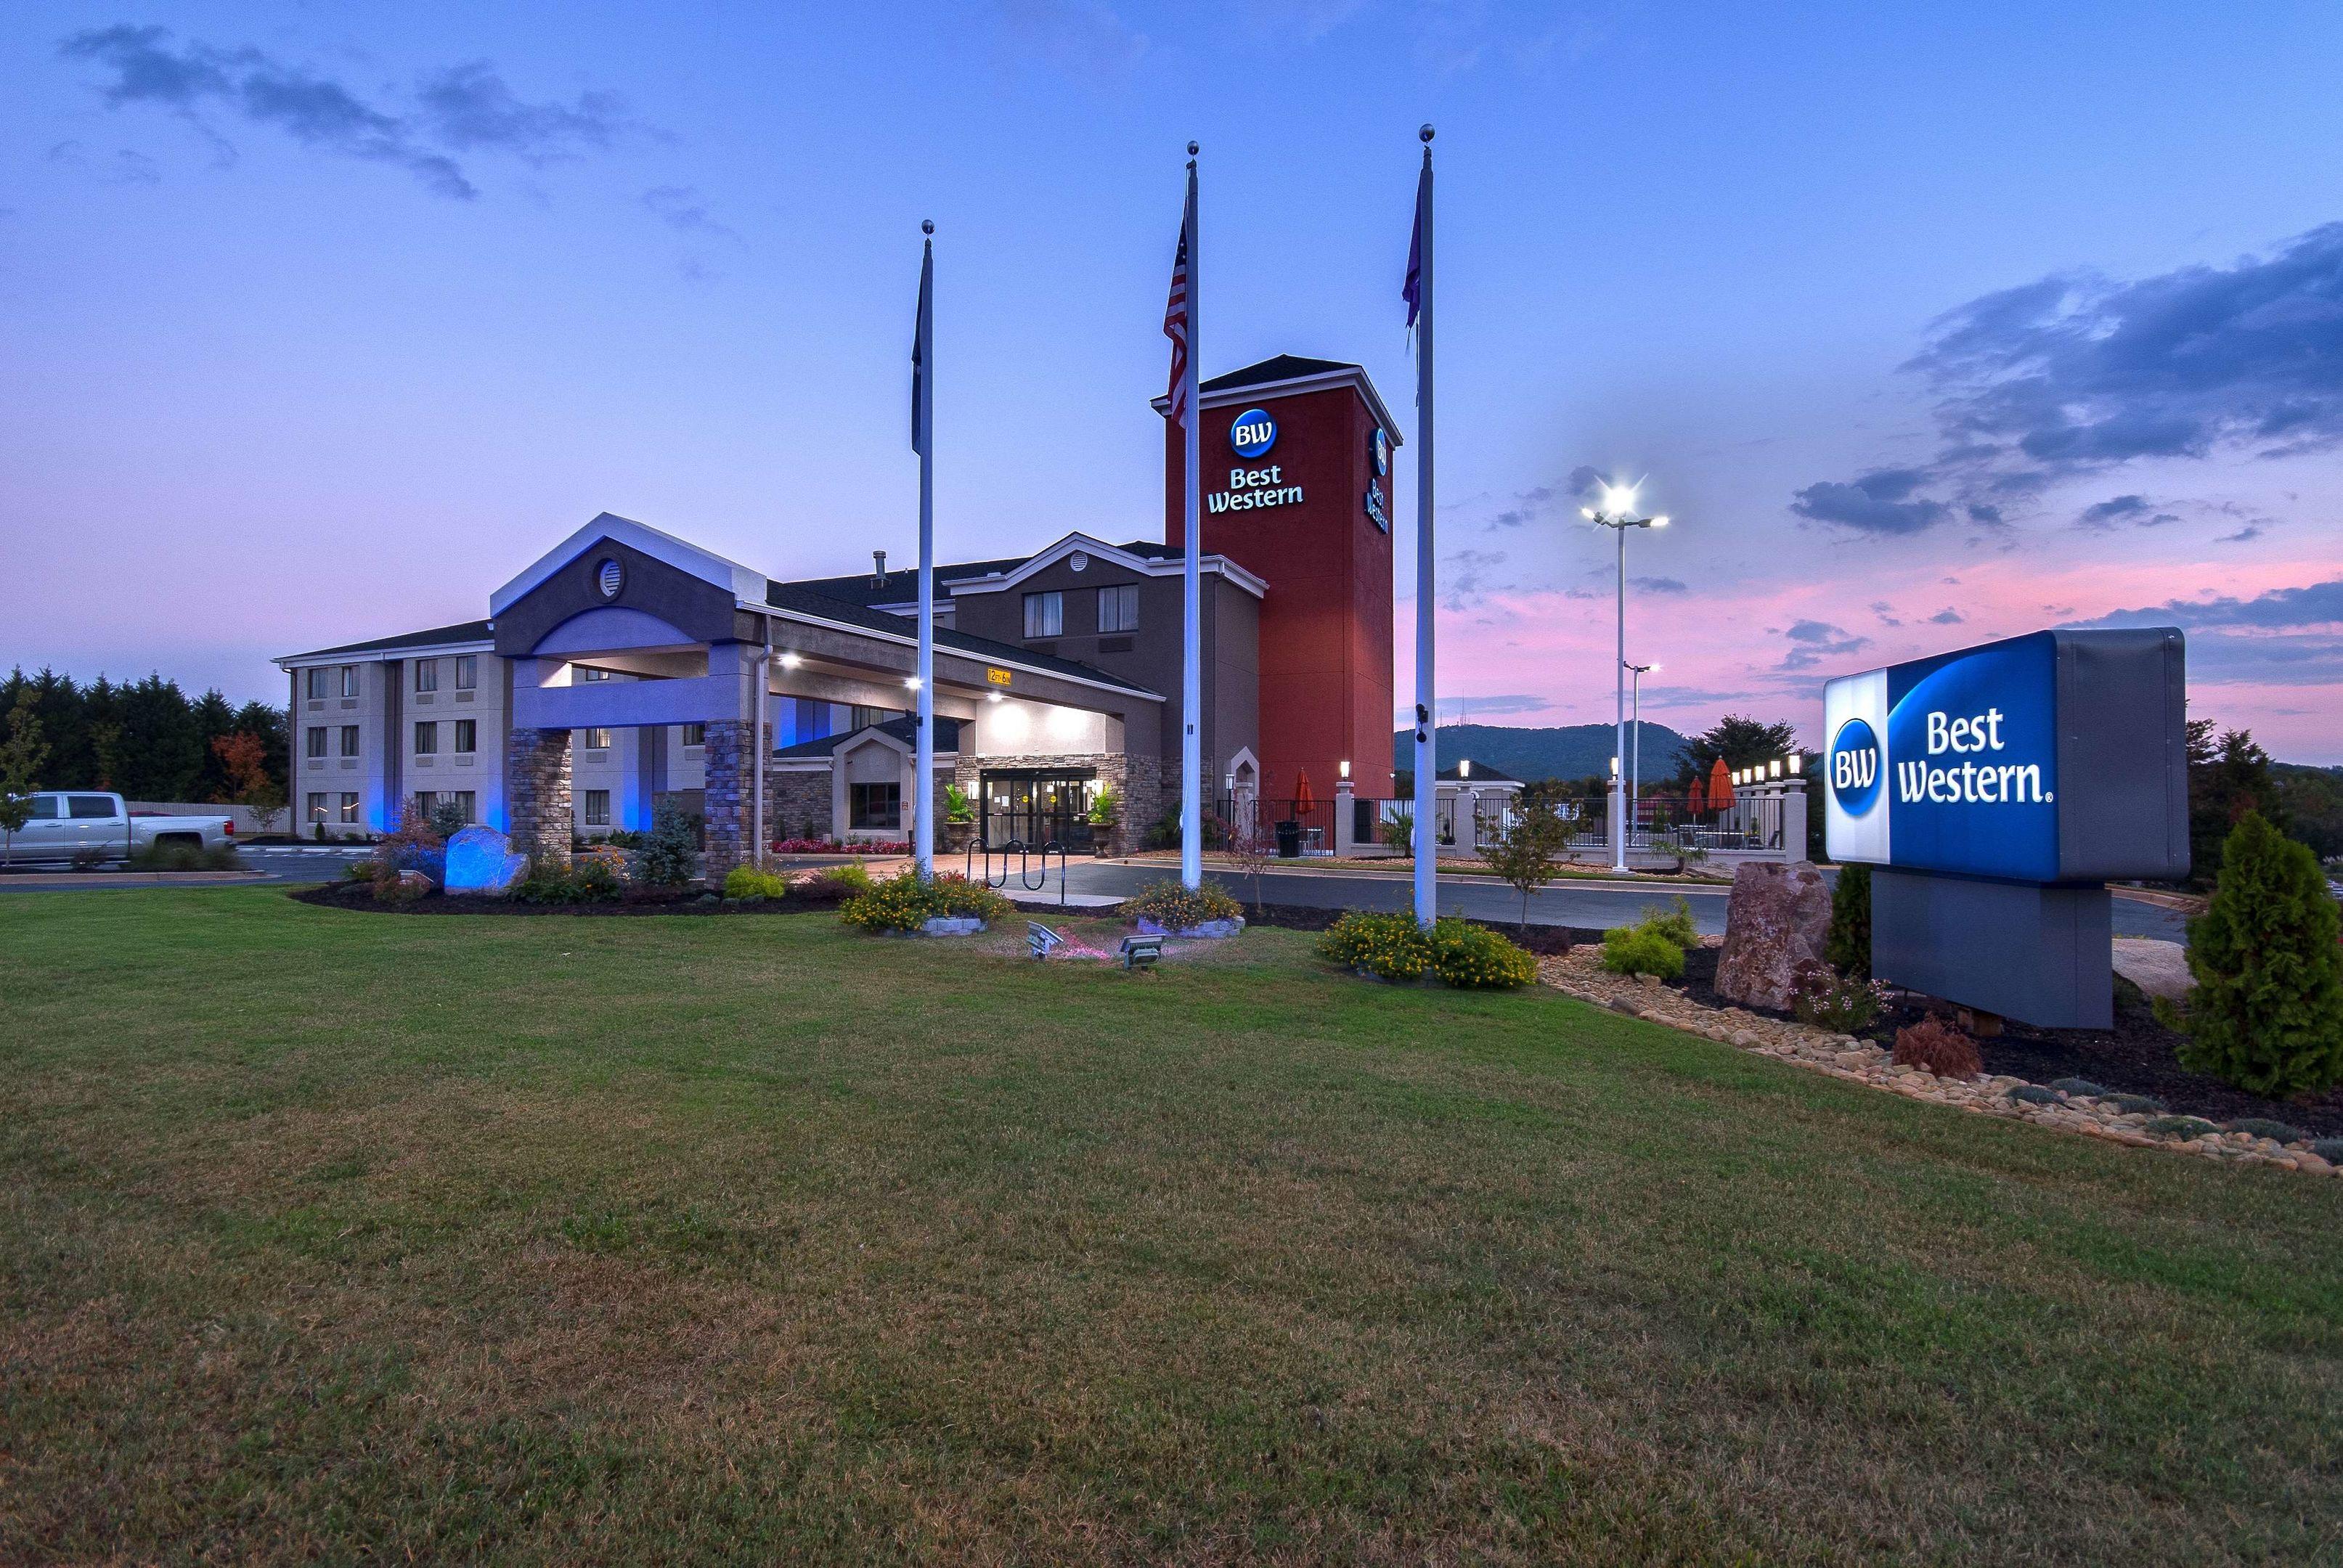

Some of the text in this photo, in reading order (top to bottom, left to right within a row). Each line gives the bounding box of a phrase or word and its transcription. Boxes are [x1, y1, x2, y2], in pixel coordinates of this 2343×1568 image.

[1236, 422, 1272, 446] BW
[1231, 465, 1281, 489] Best
[1208, 486, 1304, 513] Western
[1372, 478, 1383, 508] Best
[1367, 492, 1388, 534] Western
[1928, 708, 2004, 755] Best
[1835, 748, 1875, 789] BW
